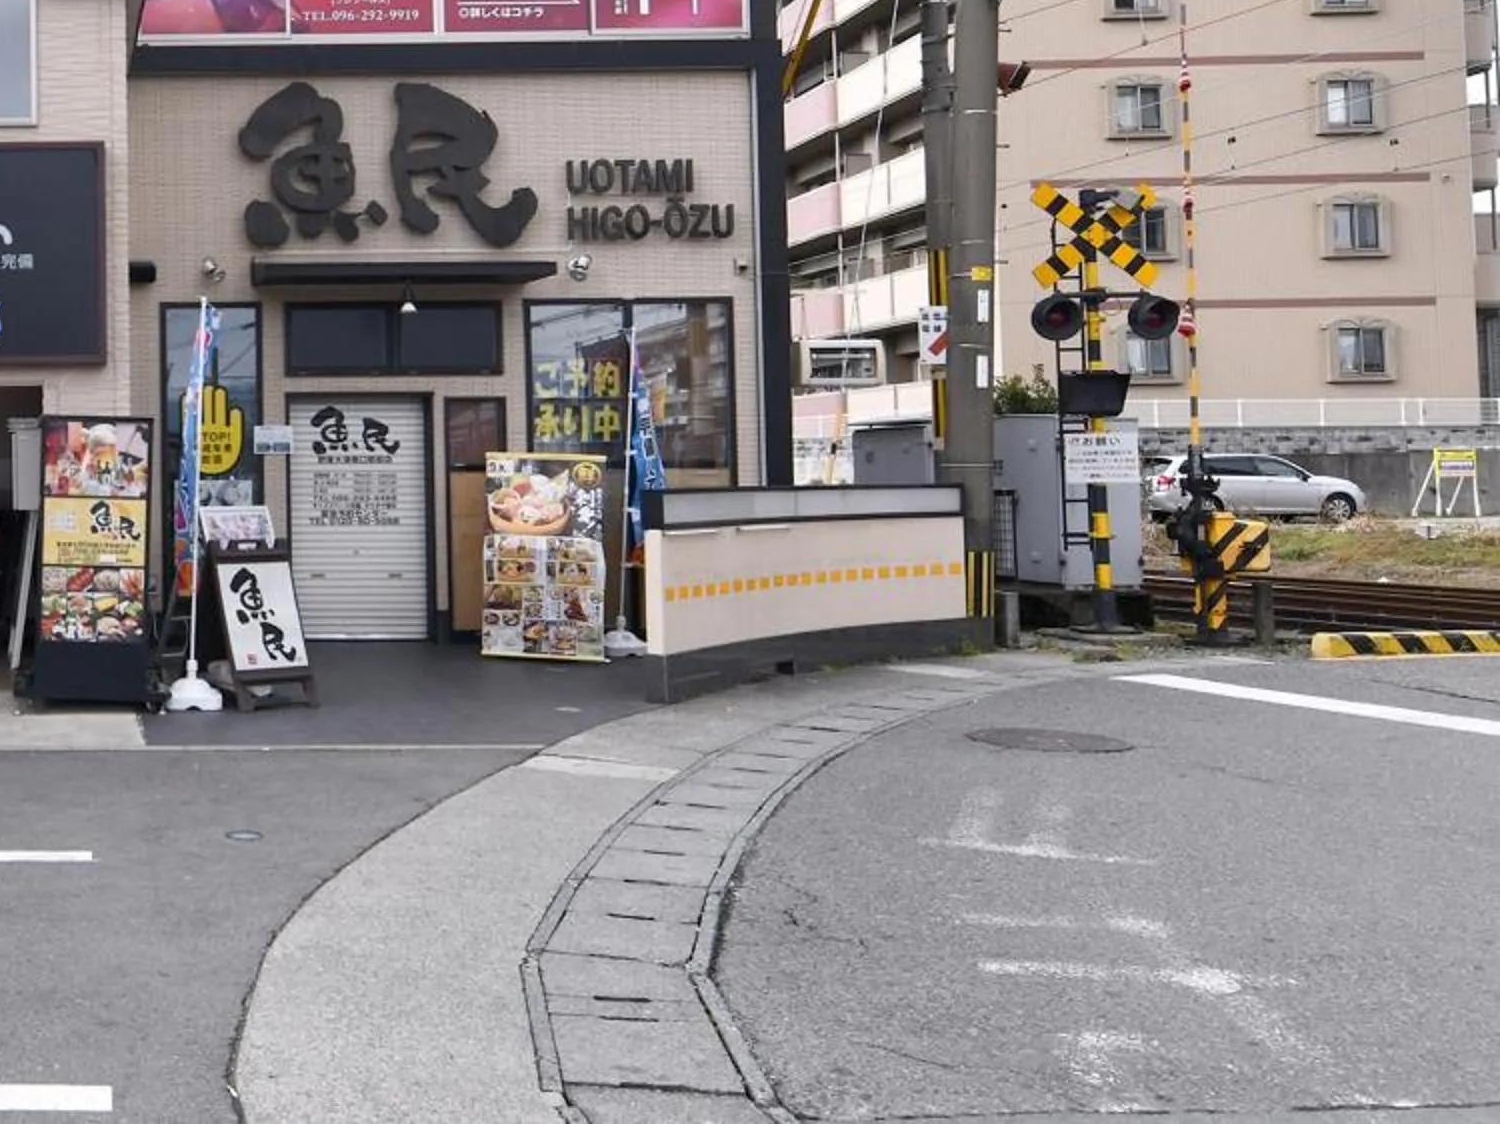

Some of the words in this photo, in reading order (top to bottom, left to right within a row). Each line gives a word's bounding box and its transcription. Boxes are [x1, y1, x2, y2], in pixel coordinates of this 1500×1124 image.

[238, 80, 539, 249] 魚民
[565, 158, 694, 195] UOTAMI
[534, 361, 622, 398] ご予約
[200, 432, 231, 442] TOP!
[310, 405, 400, 455] 魚民
[533, 405, 622, 443] 承り中
[88, 499, 142, 541] 魚民
[229, 566, 297, 663] 魚民
